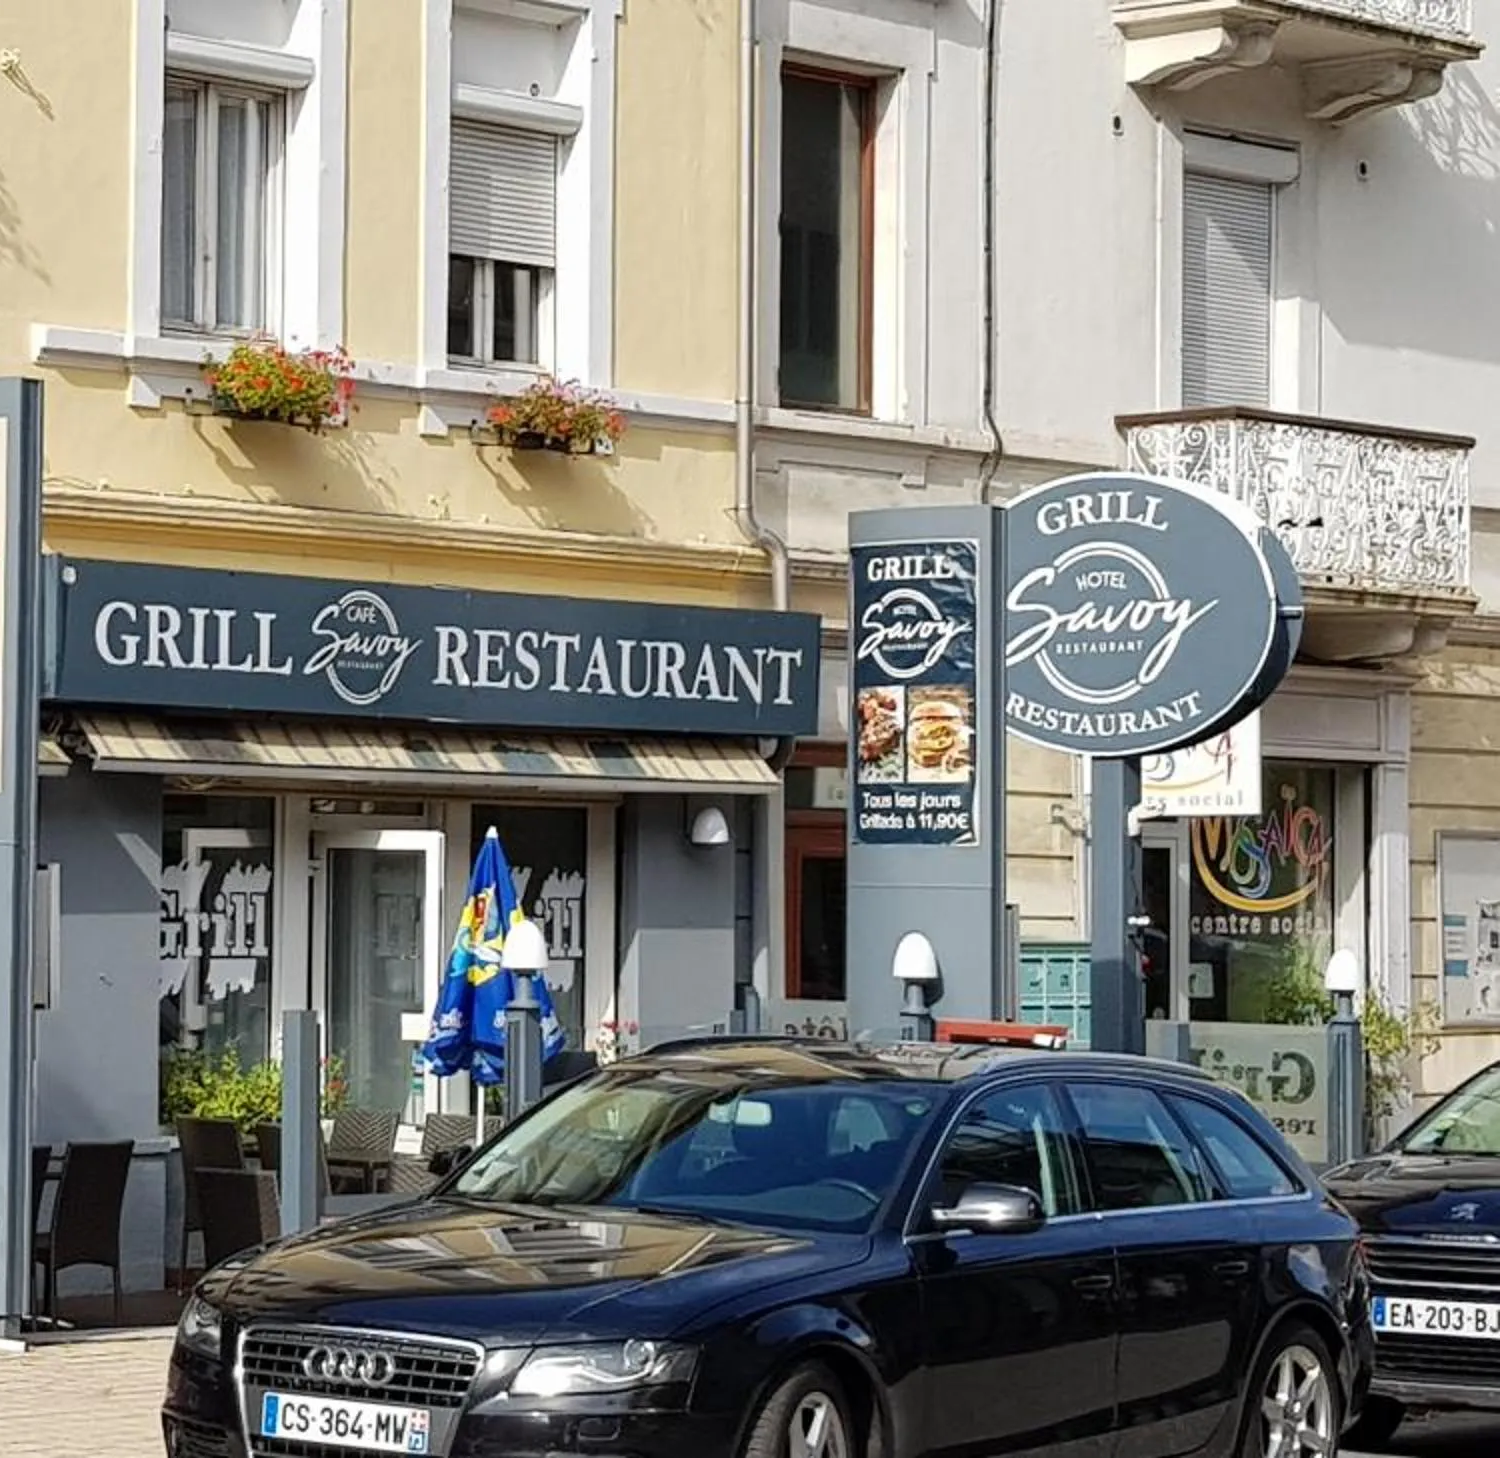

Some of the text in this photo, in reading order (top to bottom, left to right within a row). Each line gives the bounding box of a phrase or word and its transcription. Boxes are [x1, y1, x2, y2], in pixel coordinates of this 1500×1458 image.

[1036, 490, 1169, 536] GRILL
[867, 554, 955, 583] GRILL
[1075, 570, 1128, 592] HOTEL
[346, 604, 378, 625] CAFÉ
[857, 601, 972, 667] Savoy
[1006, 566, 1219, 685] Savoy
[94, 600, 294, 676] GRILL
[302, 604, 424, 694] Savoy
[1055, 639, 1145, 655] RESTAURANT
[431, 624, 803, 706] RESTAURANT
[1006, 690, 1202, 738] RESTAURANT
[861, 791, 961, 813] Tous les jours
[1190, 912, 1262, 936] centre
